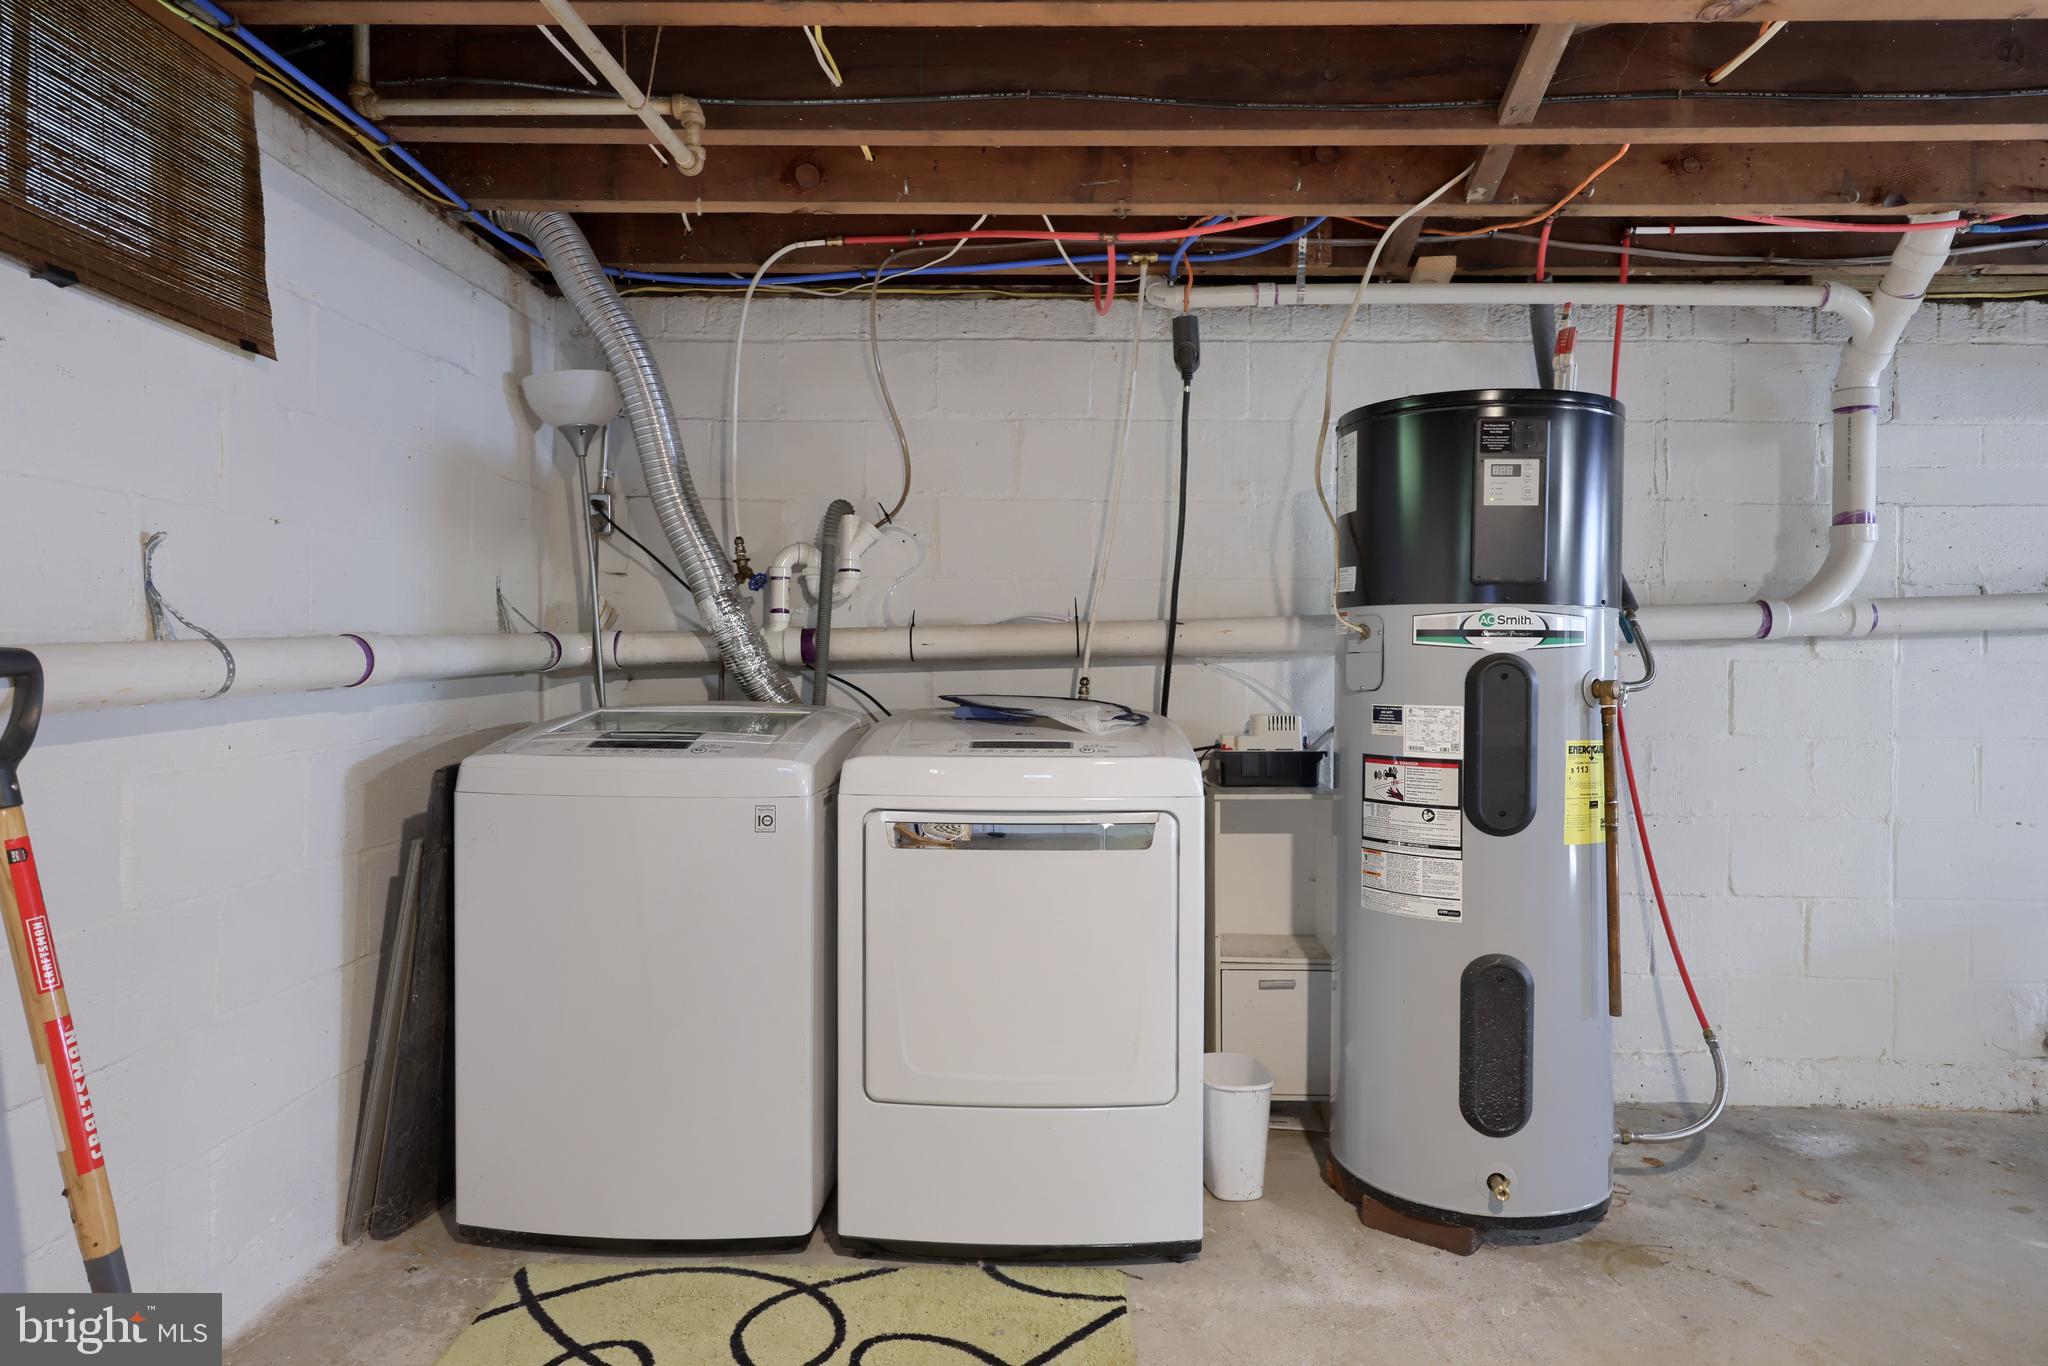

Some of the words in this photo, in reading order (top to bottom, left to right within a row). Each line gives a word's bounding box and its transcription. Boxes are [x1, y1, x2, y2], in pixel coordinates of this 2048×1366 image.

[1497, 615, 1532, 625] Smith
[1576, 765, 1589, 773] 113
[34, 921, 57, 985] CRAFTSMAN
